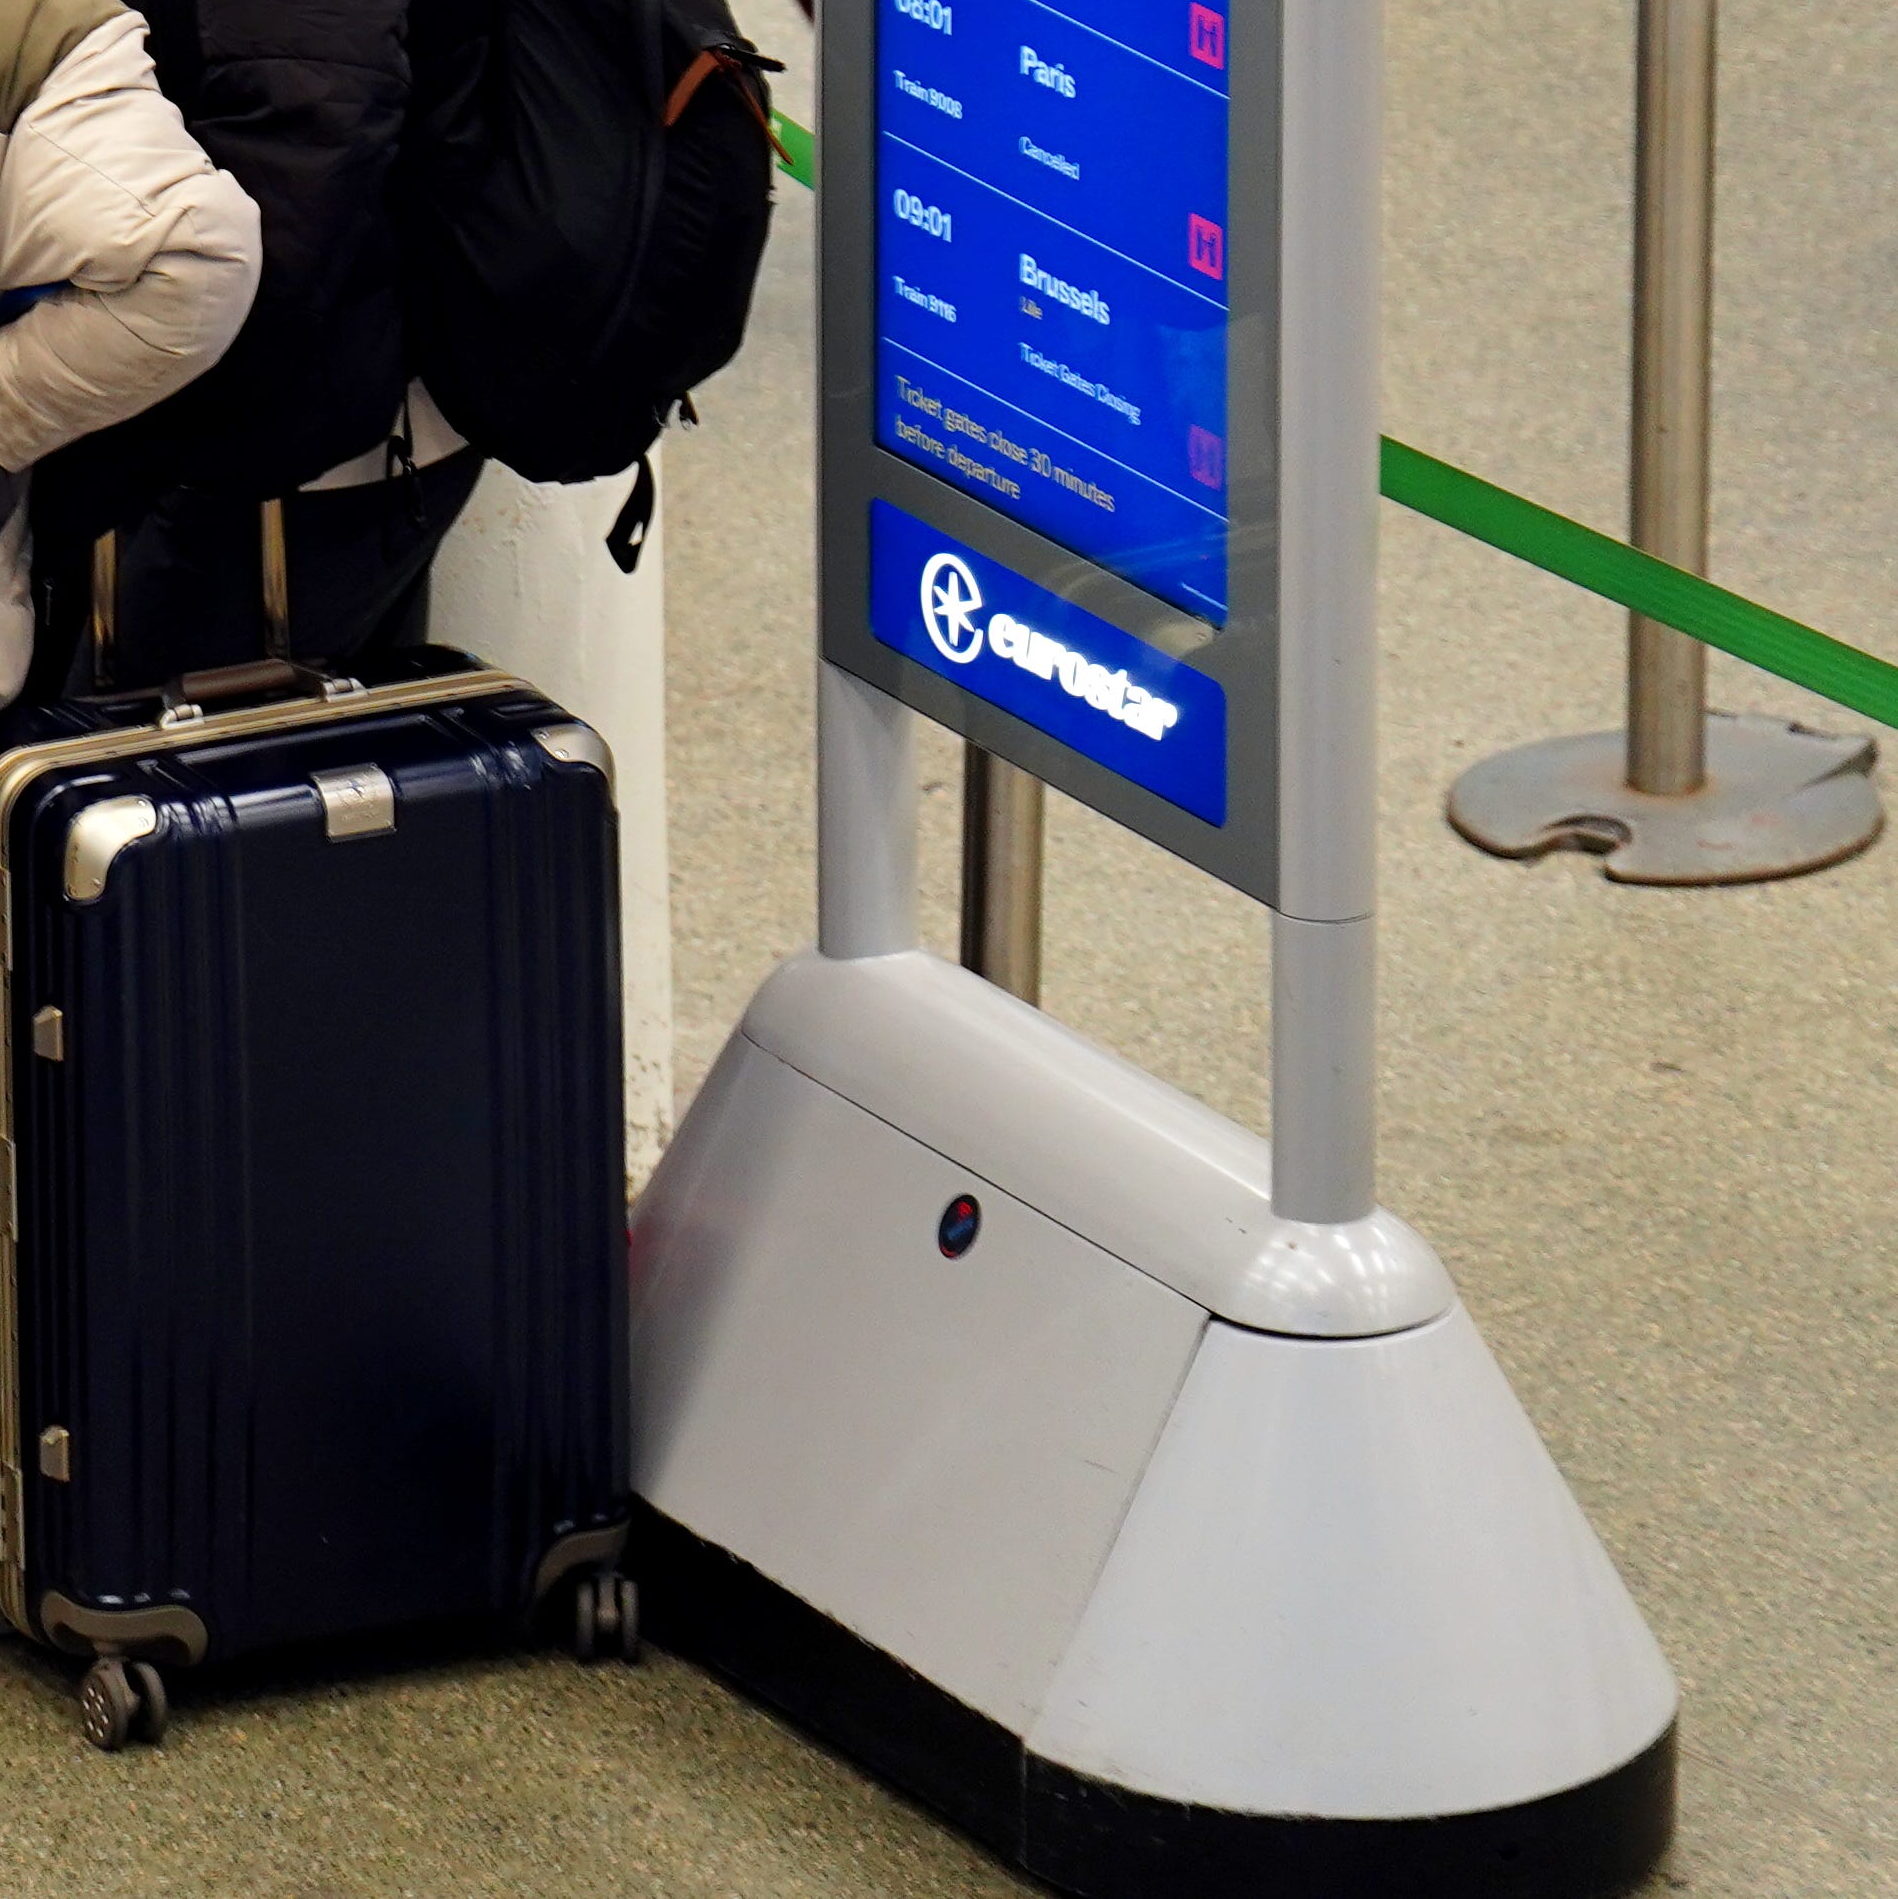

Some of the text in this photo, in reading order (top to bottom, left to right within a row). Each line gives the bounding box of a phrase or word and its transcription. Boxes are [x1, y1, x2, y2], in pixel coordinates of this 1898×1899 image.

[893, 70, 929, 103] Train
[1019, 45, 1076, 99] Paris
[1018, 136, 1080, 181] Cancelled
[892, 275, 928, 310] Train
[893, 188, 1111, 326] 09:01 Brussels
[1020, 341, 1142, 426] Ticket Gates Closing
[894, 375, 1116, 513] Ticket gates close 30 minutes
[894, 414, 1021, 500] before departure
[988, 612, 1179, 742] eurostar
